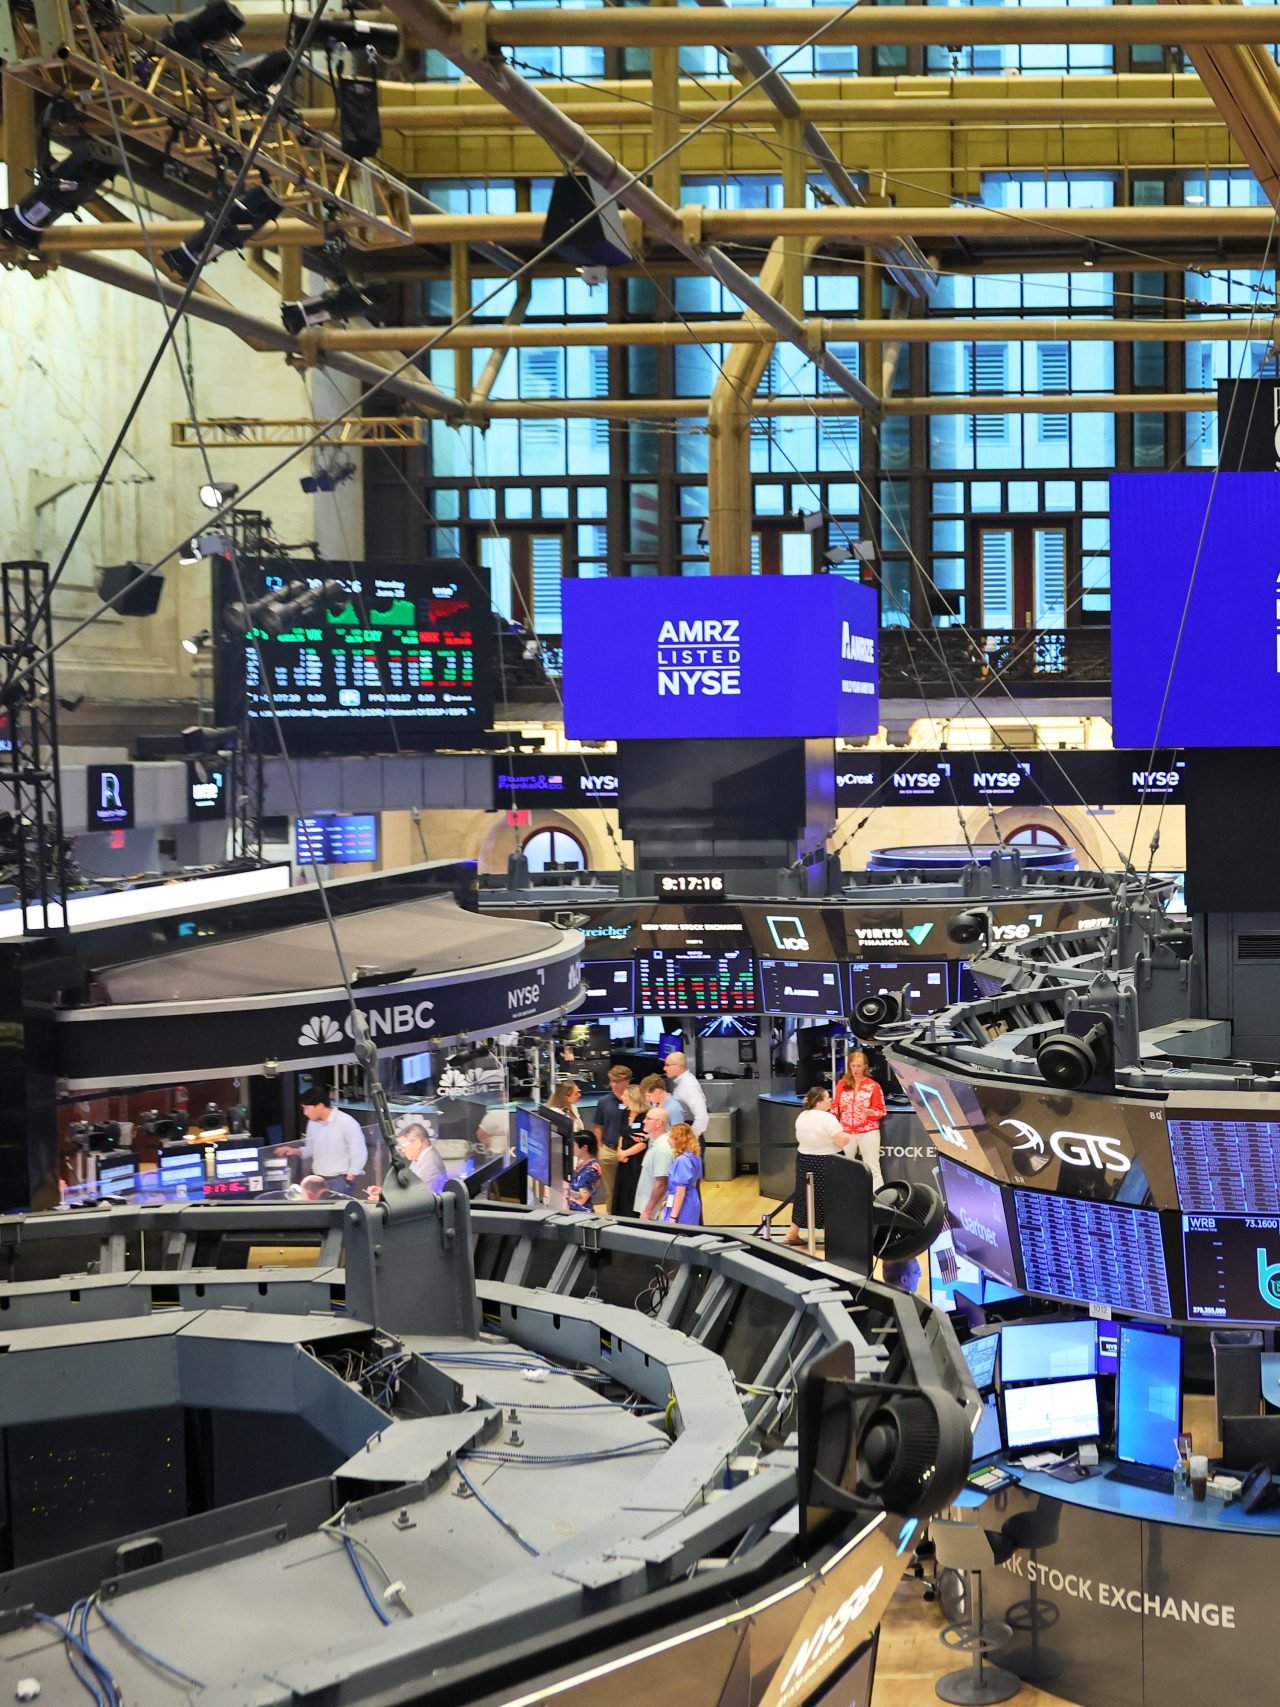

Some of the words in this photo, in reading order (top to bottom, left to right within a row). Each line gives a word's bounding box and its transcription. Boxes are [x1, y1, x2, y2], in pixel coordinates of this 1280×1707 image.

[658, 620, 740, 642] AMRZ
[658, 650, 741, 664] LISTED
[658, 671, 741, 695] NYSE
[662, 876, 723, 892] 9:17:16
[855, 928, 904, 939] VIRTU
[344, 1001, 435, 1039] CNBC
[879, 1147, 923, 1157] STOCK
[1050, 1131, 1131, 1172] GTS
[1190, 1218, 1216, 1228] WRB
[1245, 1219, 1277, 1229] 73.1600
[1027, 1560, 1093, 1601] STOCK
[1098, 1582, 1236, 1628] EXCHANGE
